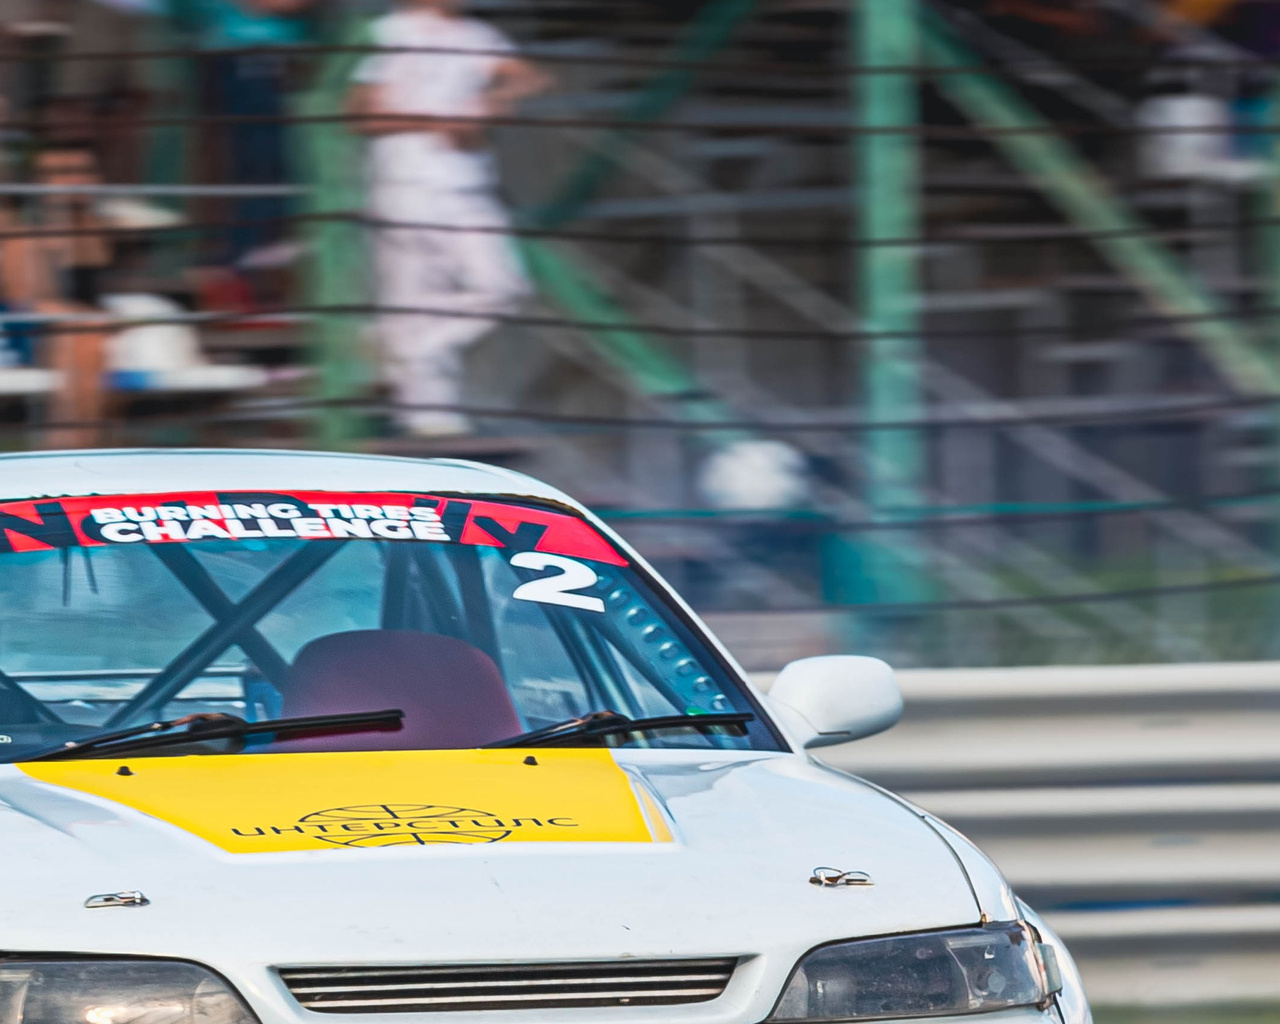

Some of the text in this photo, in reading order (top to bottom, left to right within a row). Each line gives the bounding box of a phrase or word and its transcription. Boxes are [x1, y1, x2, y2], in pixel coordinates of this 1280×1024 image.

[90, 502, 441, 524] BURNING TIRES
[100, 516, 451, 543] CHALLENGE
[509, 551, 606, 613] 2
